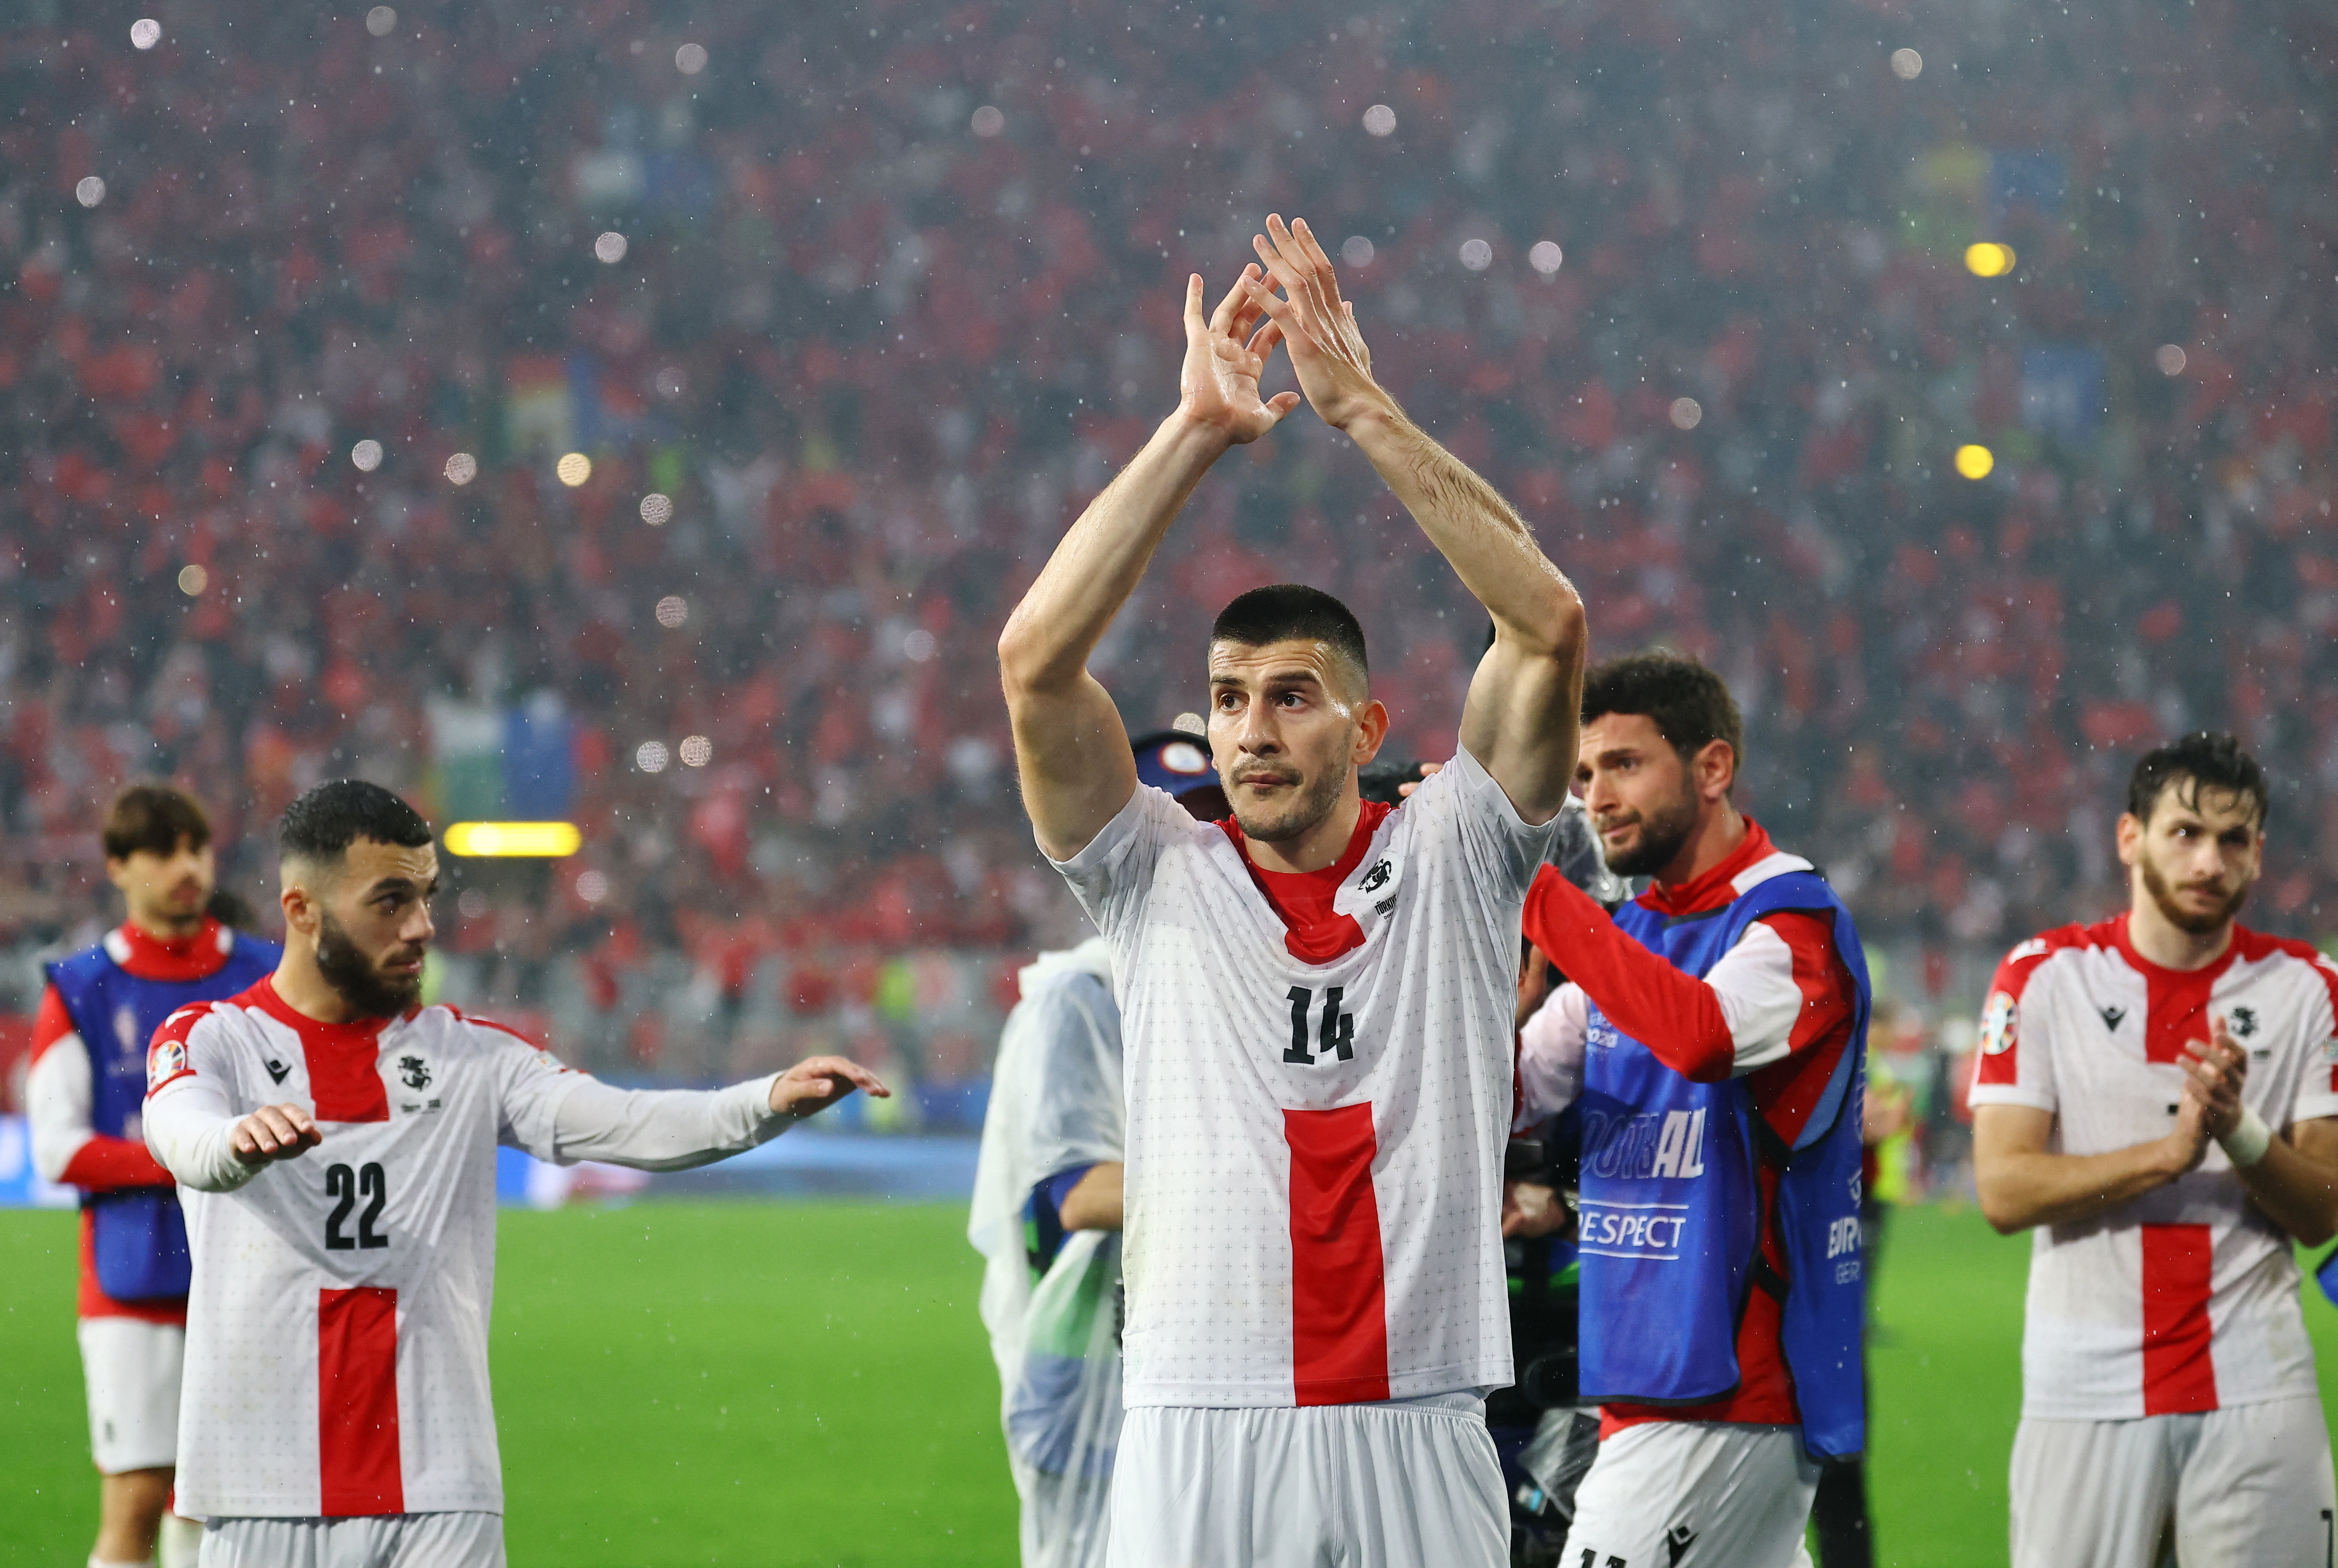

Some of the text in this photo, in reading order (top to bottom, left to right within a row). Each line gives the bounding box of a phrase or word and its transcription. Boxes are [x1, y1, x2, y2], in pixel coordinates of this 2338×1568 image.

[1283, 985, 1354, 1065] 14
[326, 1162, 389, 1250] 22
[1578, 1211, 1687, 1248] ESPECT
[1828, 1217, 1862, 1259] EUR
